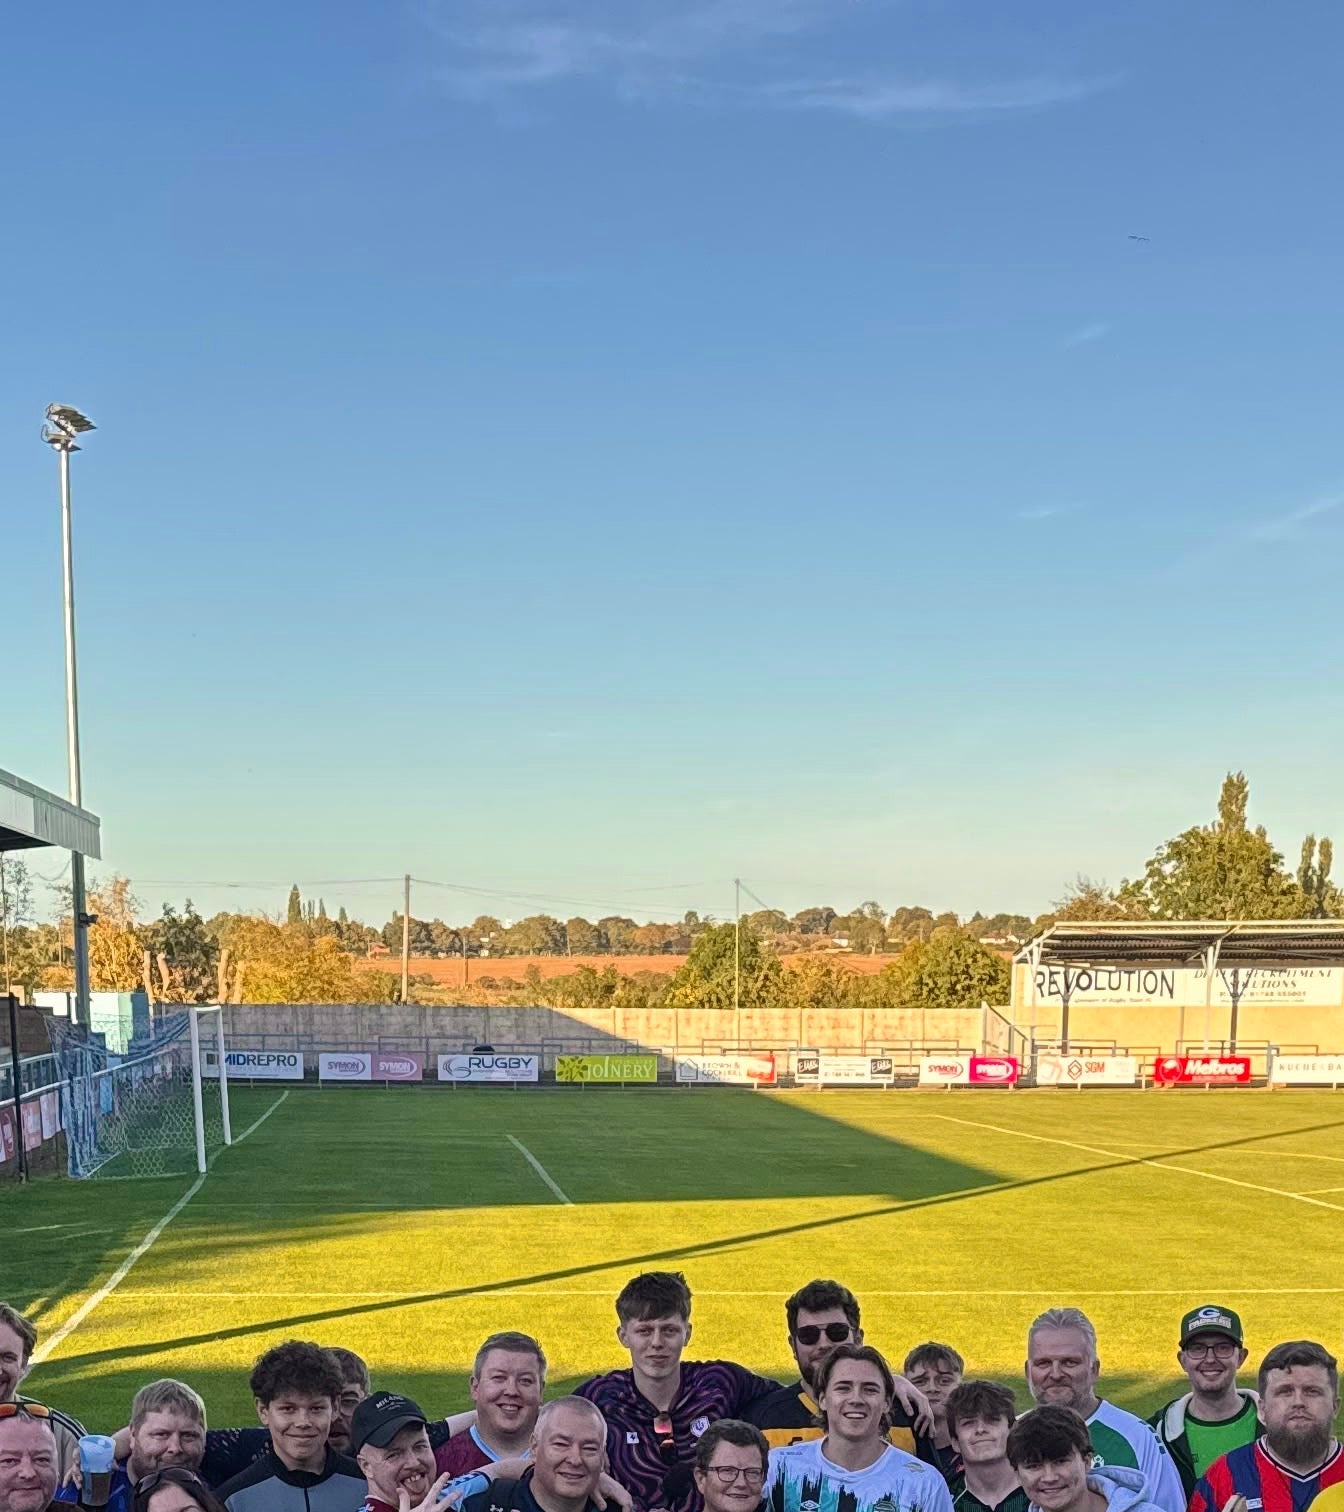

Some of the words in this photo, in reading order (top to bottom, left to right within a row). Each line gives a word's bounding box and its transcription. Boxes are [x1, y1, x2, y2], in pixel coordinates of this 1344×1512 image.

[1036, 968, 1175, 1000] REVOLUTION
[327, 1060, 359, 1070] SYMON
[468, 1056, 533, 1069] RUGBY
[586, 1056, 654, 1079] JOINERY
[927, 1063, 958, 1074] SYMON
[1085, 1061, 1105, 1074] SGM
[1184, 1059, 1245, 1076] Melbros
